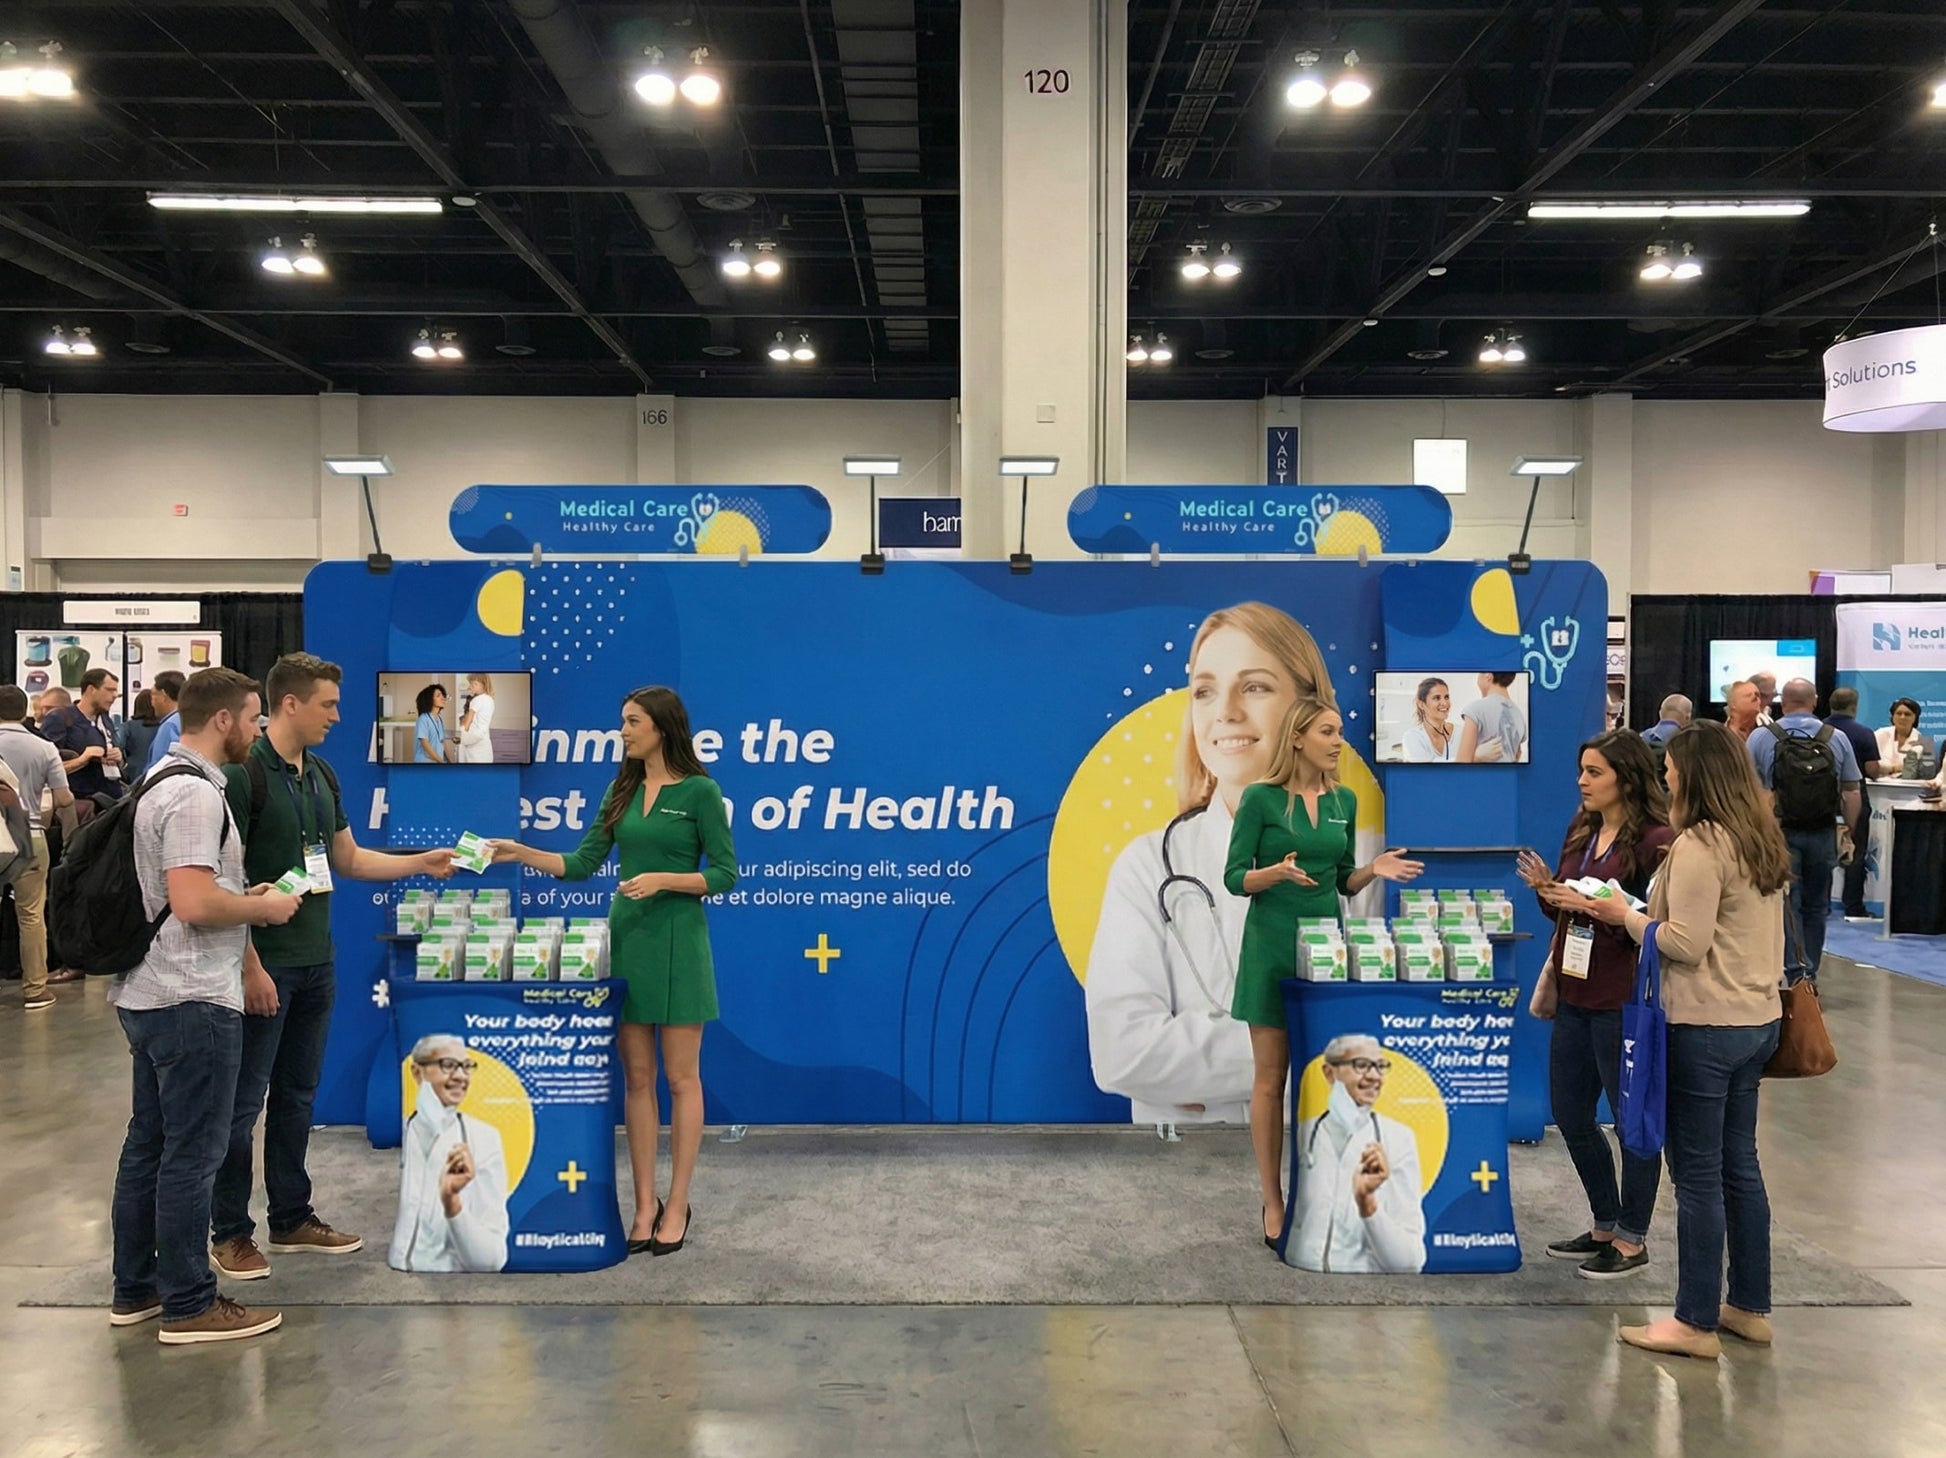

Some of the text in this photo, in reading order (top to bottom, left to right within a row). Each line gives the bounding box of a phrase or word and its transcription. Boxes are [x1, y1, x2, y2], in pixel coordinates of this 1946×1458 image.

[1024, 69, 1069, 94] 120
[1832, 360, 1917, 389] Solutions
[643, 409, 668, 425] 166
[560, 499, 688, 517] Medical Care
[1180, 499, 1308, 517] Medical Care
[563, 521, 656, 534] Healthy Care
[1182, 521, 1275, 534] Healthy Care
[1908, 627, 1945, 639] Heal
[740, 718, 835, 763] the
[751, 785, 814, 830] of
[824, 785, 1014, 830] Health
[763, 860, 862, 881] adipiscing
[868, 860, 902, 879] elit,
[907, 860, 941, 877] sed
[946, 860, 972, 877] do
[537, 888, 556, 905] of
[560, 892, 604, 909] your
[729, 889, 748, 905] et
[753, 888, 814, 905] dolore
[820, 891, 887, 909] magne
[892, 888, 956, 908] alique.
[465, 1014, 510, 1028] Your
[515, 1014, 566, 1032] body
[1381, 1014, 1427, 1028] Your
[1430, 1014, 1480, 1032] body
[468, 1032, 577, 1051] everything
[1383, 1032, 1490, 1051] everything
